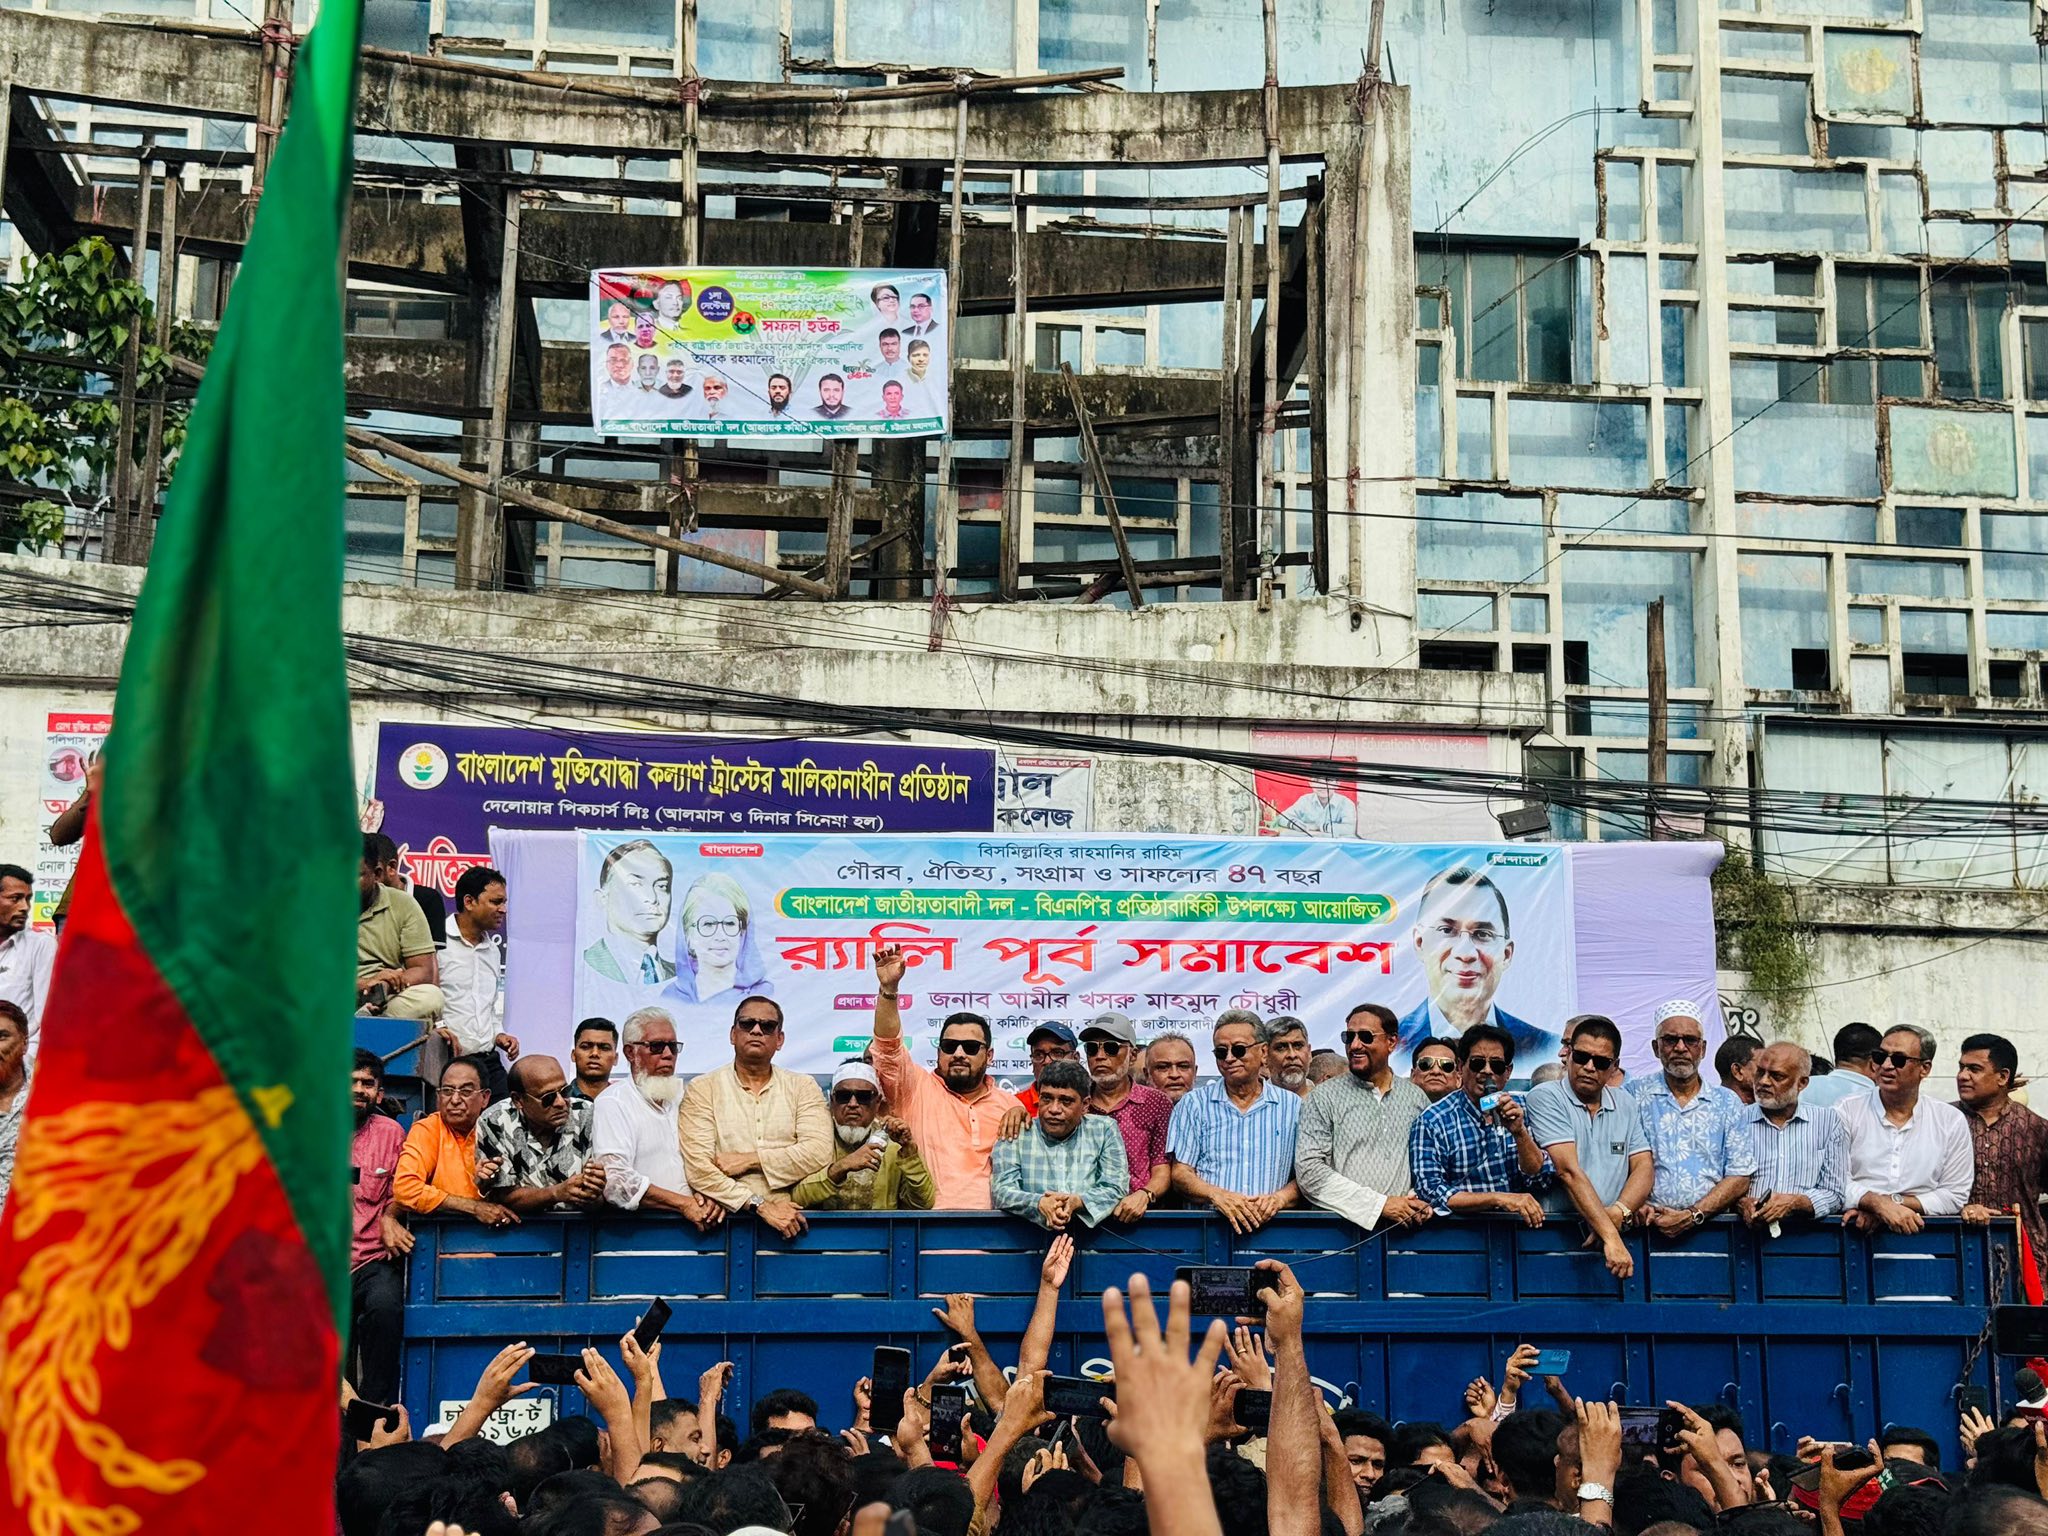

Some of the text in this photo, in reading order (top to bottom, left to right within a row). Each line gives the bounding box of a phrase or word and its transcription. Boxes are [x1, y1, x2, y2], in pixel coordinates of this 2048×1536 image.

[761, 317, 841, 333] সফল হউক
[730, 354, 776, 365] রহমানের
[1256, 734, 1311, 749] Traditional
[1313, 739, 1324, 749] or
[1328, 736, 1358, 750] Moral
[1418, 738, 1437, 752] You
[455, 747, 972, 805] বাংলাদেশ মুক্তিযোদ্ধা কল্যাণ ট্রাস্টের মালিকানাধীন প্রতিষ্ঠান
[482, 799, 884, 832] দেলোয়ার পিকচার্স লিঃ (আলমাস ও দিনার সিনেমা হল)
[704, 844, 760, 856] বাংলাদেশ
[977, 842, 1184, 861] বিসমিল্লাহির রাহমানির রাহিম
[1493, 853, 1543, 866] জিন্দাবাদ
[1015, 866, 1086, 883] সংগ্রাম
[1094, 867, 1114, 882] ও
[1119, 866, 1219, 885] সাফল্যের
[1228, 864, 1267, 884] ৪৭
[1273, 868, 1323, 887] বছর
[790, 893, 871, 916] বাংলাদেশ
[875, 890, 983, 917] জাতীয়তাবাদী
[987, 896, 1015, 916] দল
[1116, 892, 1220, 919] প্রতিষ্ঠাবার্ষিকী
[1302, 895, 1383, 920] আয়োজিত
[983, 924, 1101, 986] পূর্ব
[1117, 938, 1396, 975] সমাবেশ
[837, 996, 864, 1007] প্রধান
[927, 991, 993, 1010] জনাব
[1000, 986, 1070, 1010] আমীর
[1078, 991, 1138, 1010] খসরু
[1143, 992, 1221, 1015] মাহমুদ
[1228, 988, 1302, 1015] চৌধুরী
[1142, 1015, 1215, 1030] জাতীয়তাবাদী
